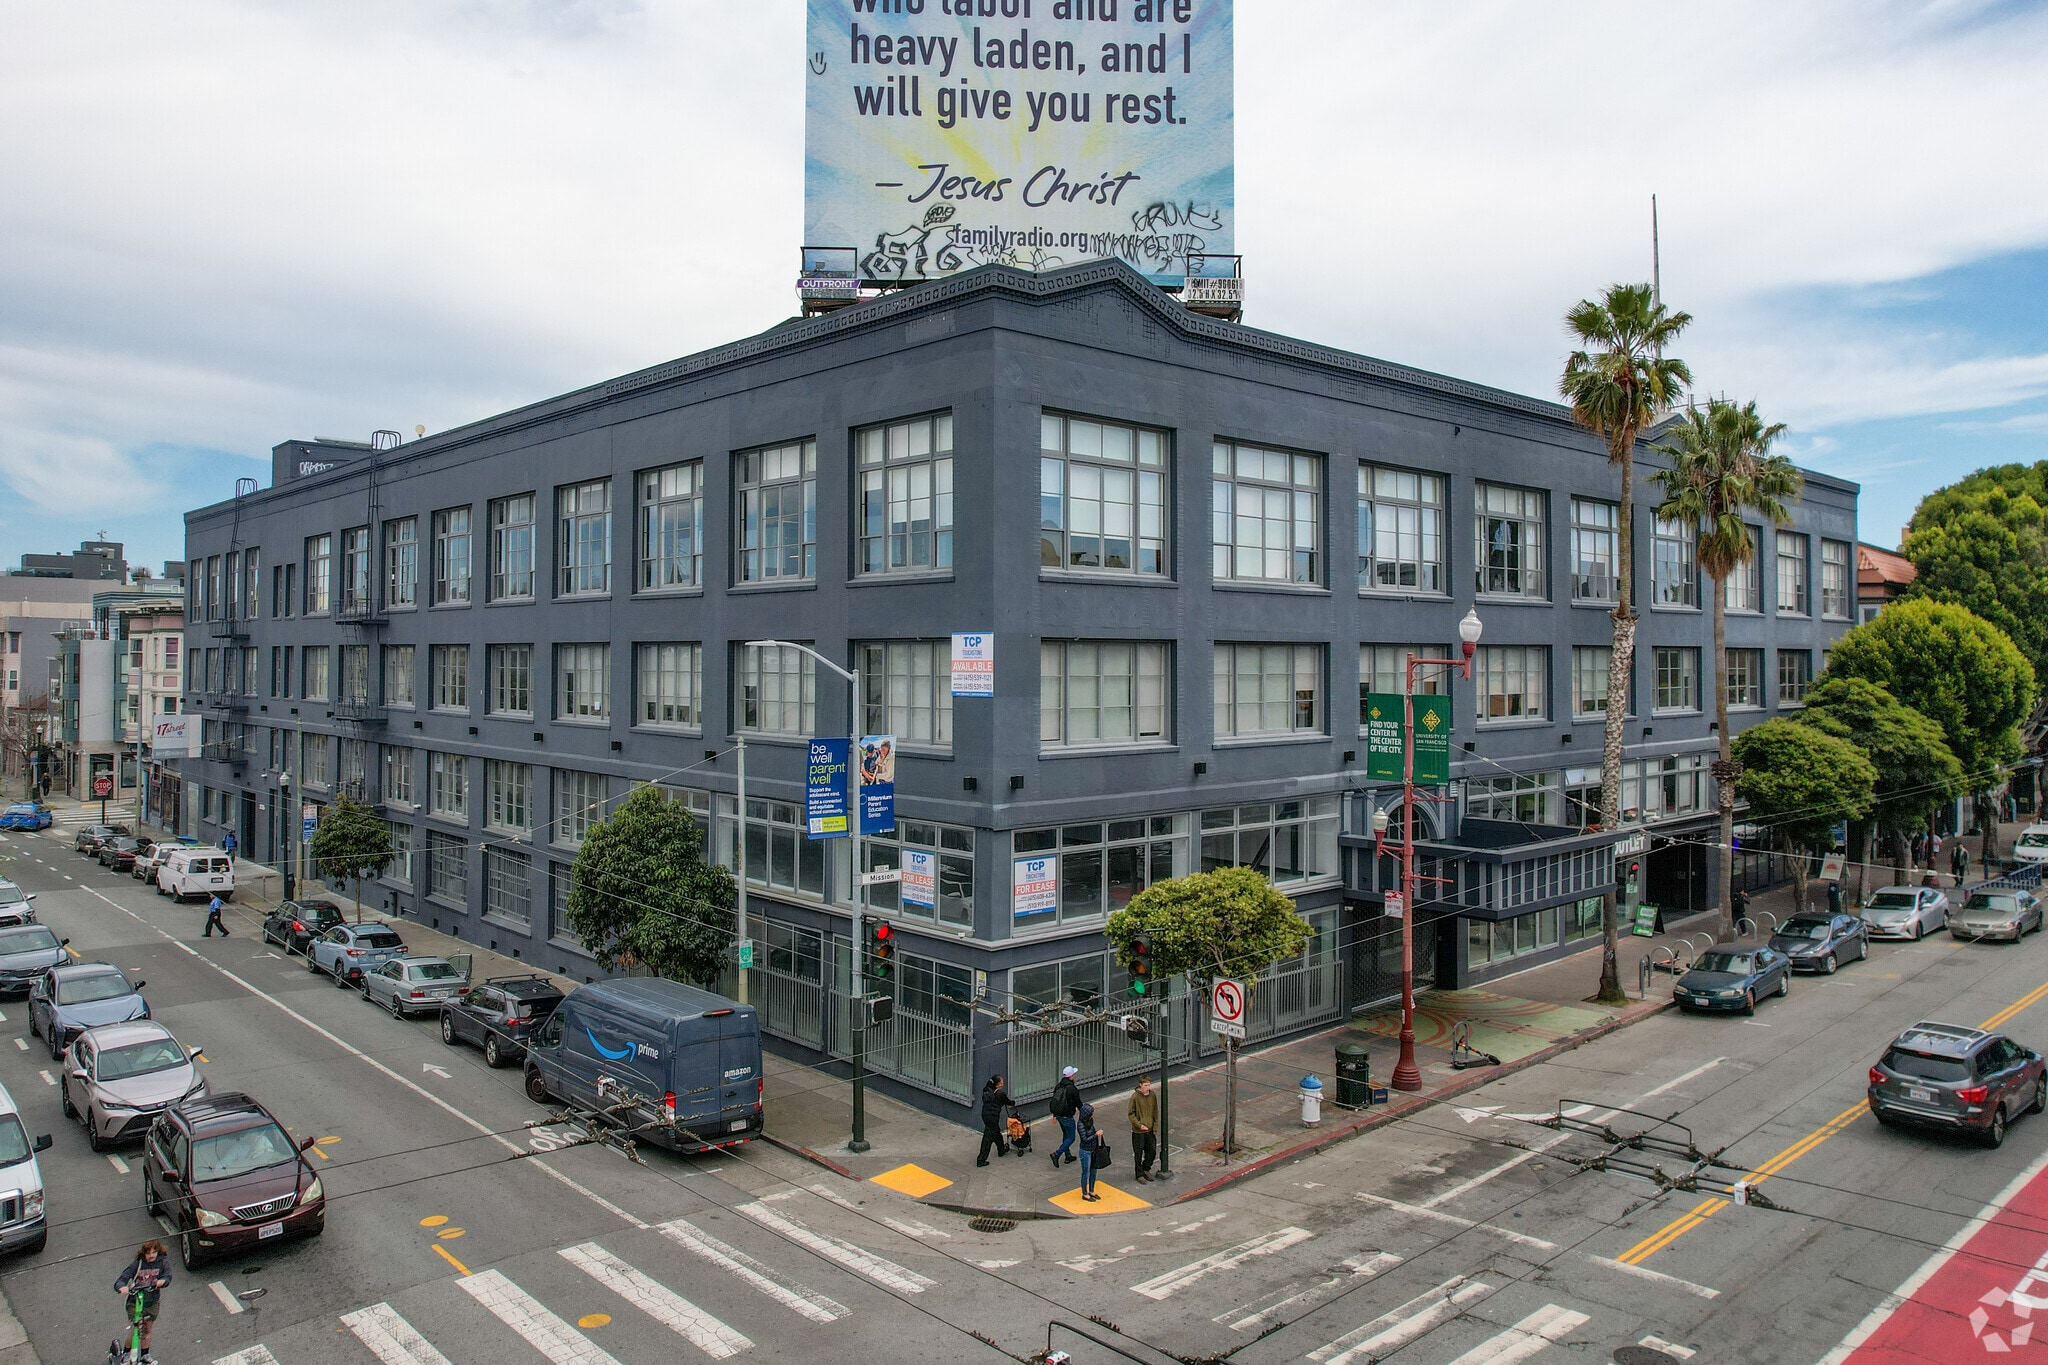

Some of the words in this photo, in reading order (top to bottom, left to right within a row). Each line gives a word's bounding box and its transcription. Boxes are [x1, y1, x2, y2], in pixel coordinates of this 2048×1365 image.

[851, 22, 958, 77] heavy
[973, 26, 1086, 76] laden,
[1101, 32, 1166, 73] and
[1183, 33, 1191, 74] I
[853, 75, 922, 116] will
[937, 77, 1011, 129] give
[1025, 91, 1090, 132] you
[1105, 86, 1187, 125] rest.
[1022, 165, 1141, 208] Christ
[954, 223, 1088, 253] familyradio.org
[802, 280, 855, 288] OUTFRONT
[963, 636, 982, 647] TCP
[952, 661, 993, 671] AVAILABLE
[1370, 720, 1383, 728] FIND
[1383, 721, 1399, 729] YOUR
[1370, 728, 1390, 737] CENTER
[1391, 729, 1397, 737] IN
[1370, 736, 1381, 744] THE
[1381, 737, 1402, 746] CENTER
[811, 743, 827, 754] be
[1378, 745, 1388, 753] THE
[810, 752, 833, 764] well
[809, 762, 846, 776] parent
[809, 774, 831, 785] well
[911, 853, 927, 865] TCP
[1027, 860, 1045, 872] TCP
[903, 873, 915, 884] FOR
[915, 874, 935, 887] LEASE
[1016, 884, 1030, 895] FOR
[1031, 880, 1055, 893] LEASE
[638, 1043, 659, 1059] prime
[724, 1066, 752, 1078] amazon
